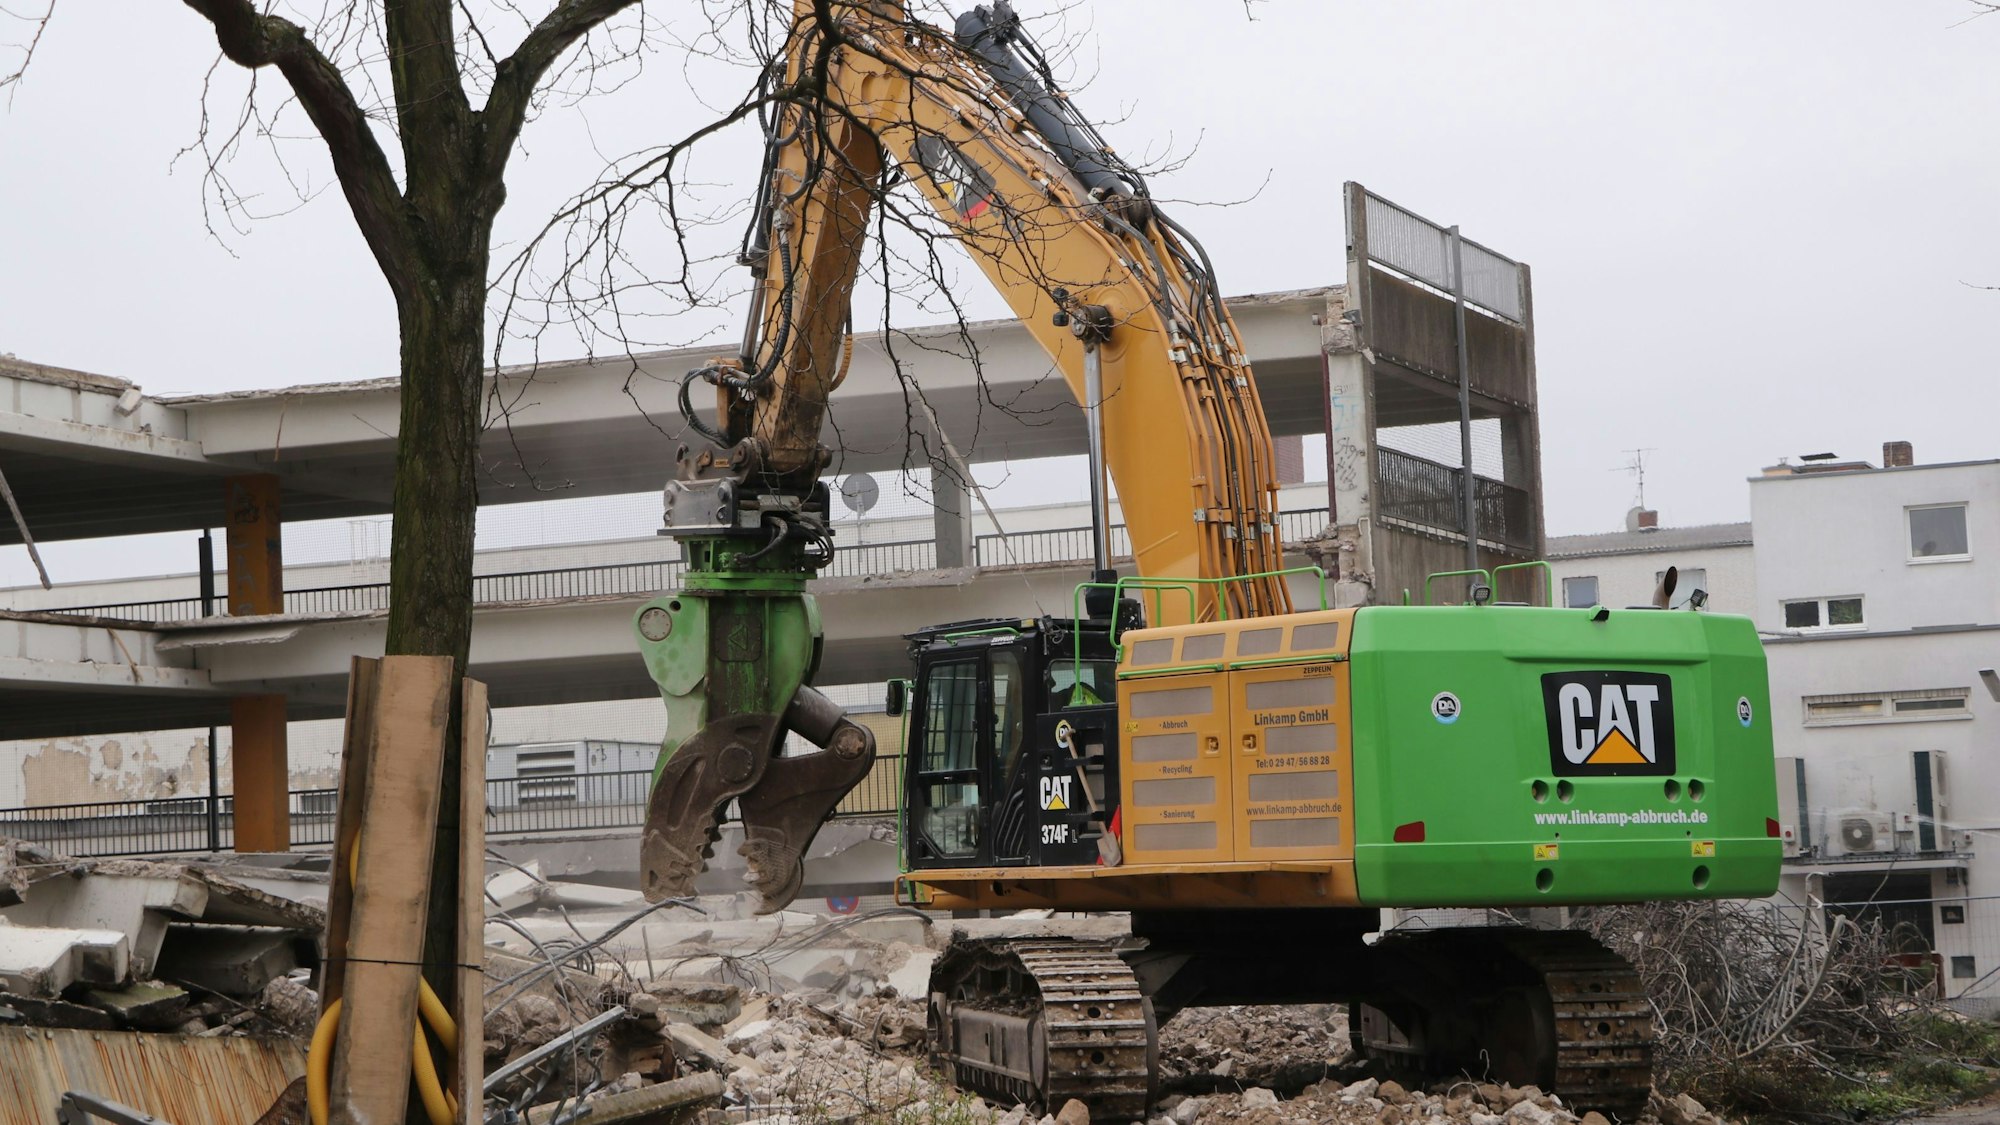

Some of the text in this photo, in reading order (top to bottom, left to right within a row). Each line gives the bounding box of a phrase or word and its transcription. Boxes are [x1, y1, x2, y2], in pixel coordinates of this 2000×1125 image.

[1303, 666, 1332, 674] ZEPPELIN
[1162, 720, 1188, 729] Abbruch
[1254, 709, 1329, 726] Linkamp GmbH
[1559, 683, 1659, 764] CAT
[1276, 758, 1285, 767] 29
[1320, 756, 1330, 765] 28
[1162, 765, 1193, 775] Recycling
[1040, 776, 1072, 810] CAT
[1163, 810, 1195, 819] Sanierung
[1246, 802, 1342, 816] www.linkamp-abbruch.de
[1534, 809, 1709, 826] www.linkamp-abbruch.de
[1041, 824, 1069, 844] 374F
